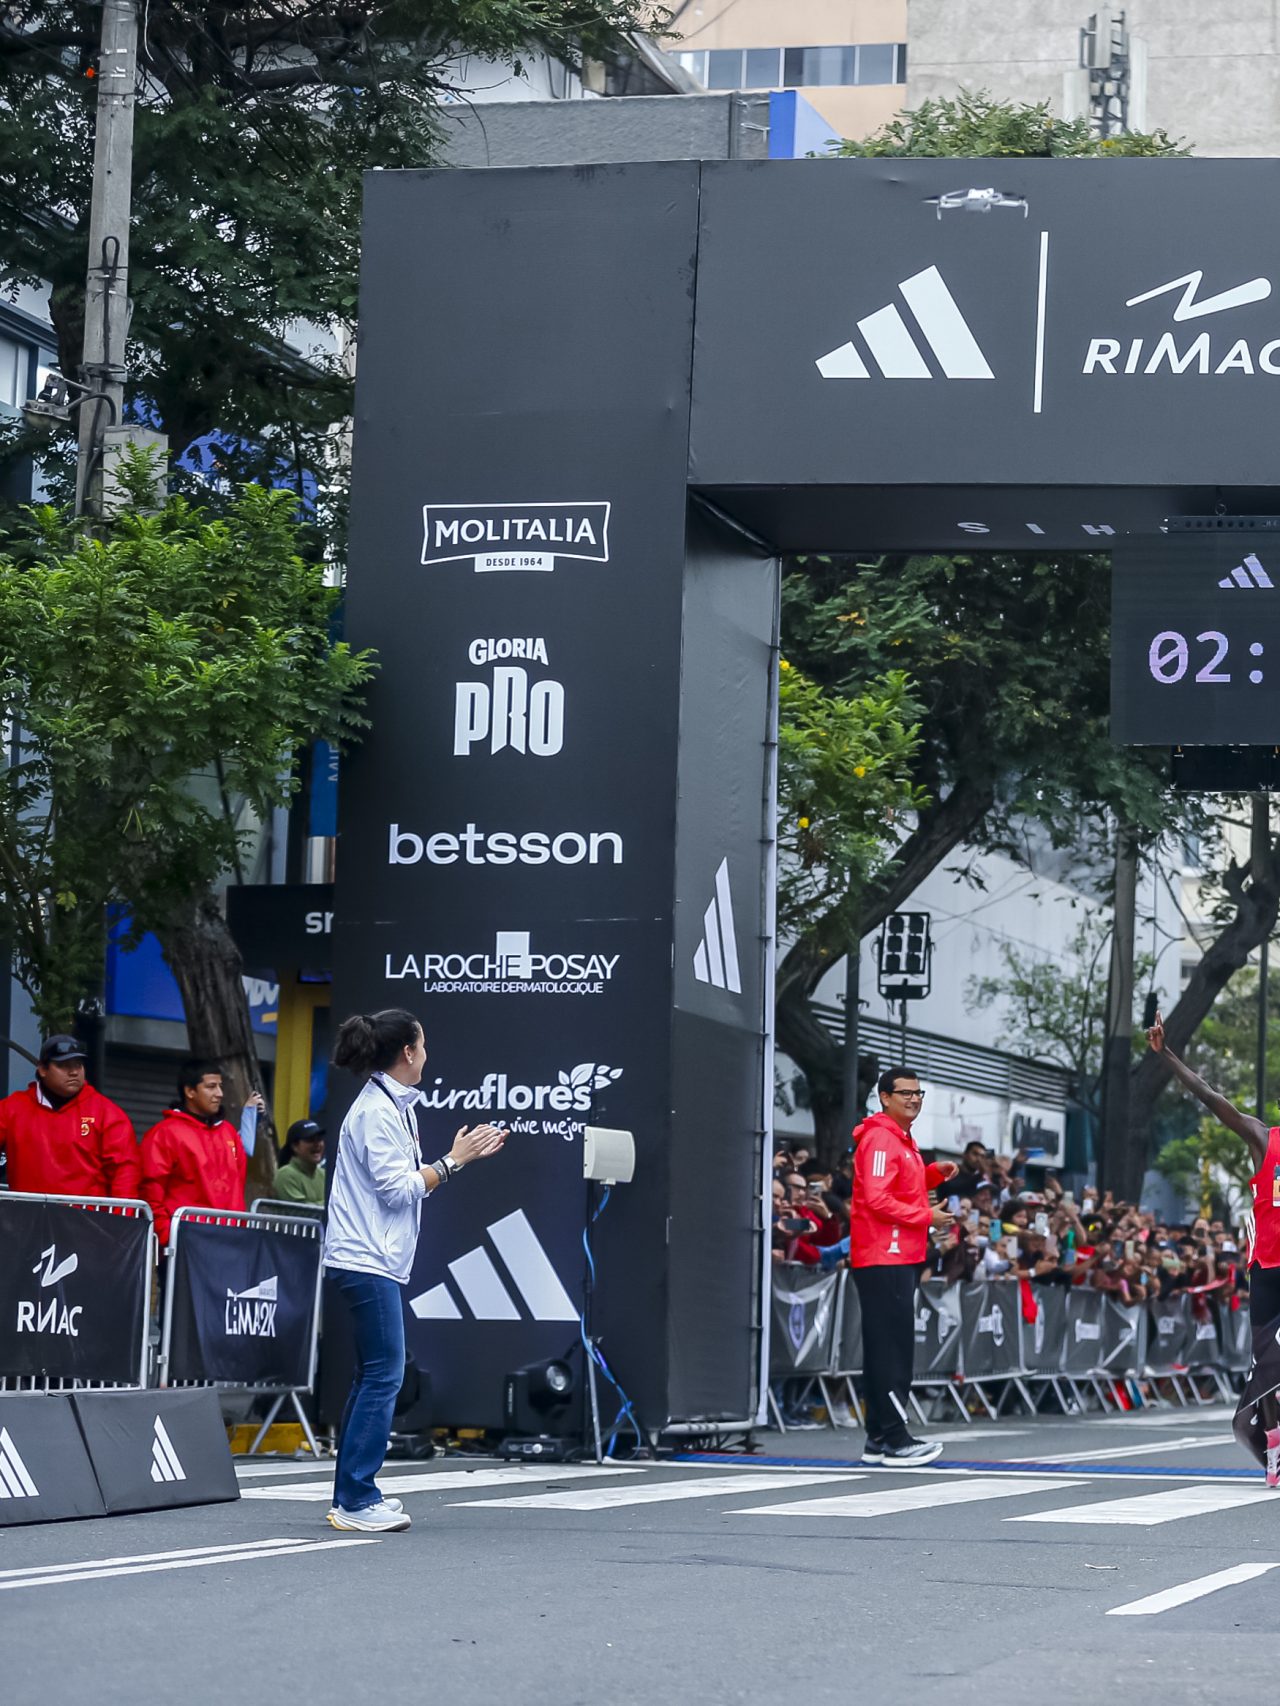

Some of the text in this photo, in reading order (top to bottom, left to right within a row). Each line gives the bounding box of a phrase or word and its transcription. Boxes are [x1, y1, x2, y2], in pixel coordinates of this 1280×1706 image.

[435, 518, 597, 547] MOLITALIA
[486, 557, 543, 567] DESDE 1964
[468, 637, 549, 666] GLORIA
[388, 823, 623, 864] betsson
[386, 954, 421, 980] LA
[424, 982, 603, 995] LABORATOIRE DERMATOLOGIQUE
[510, 1117, 539, 1134] vive
[542, 1117, 586, 1142] mejor
